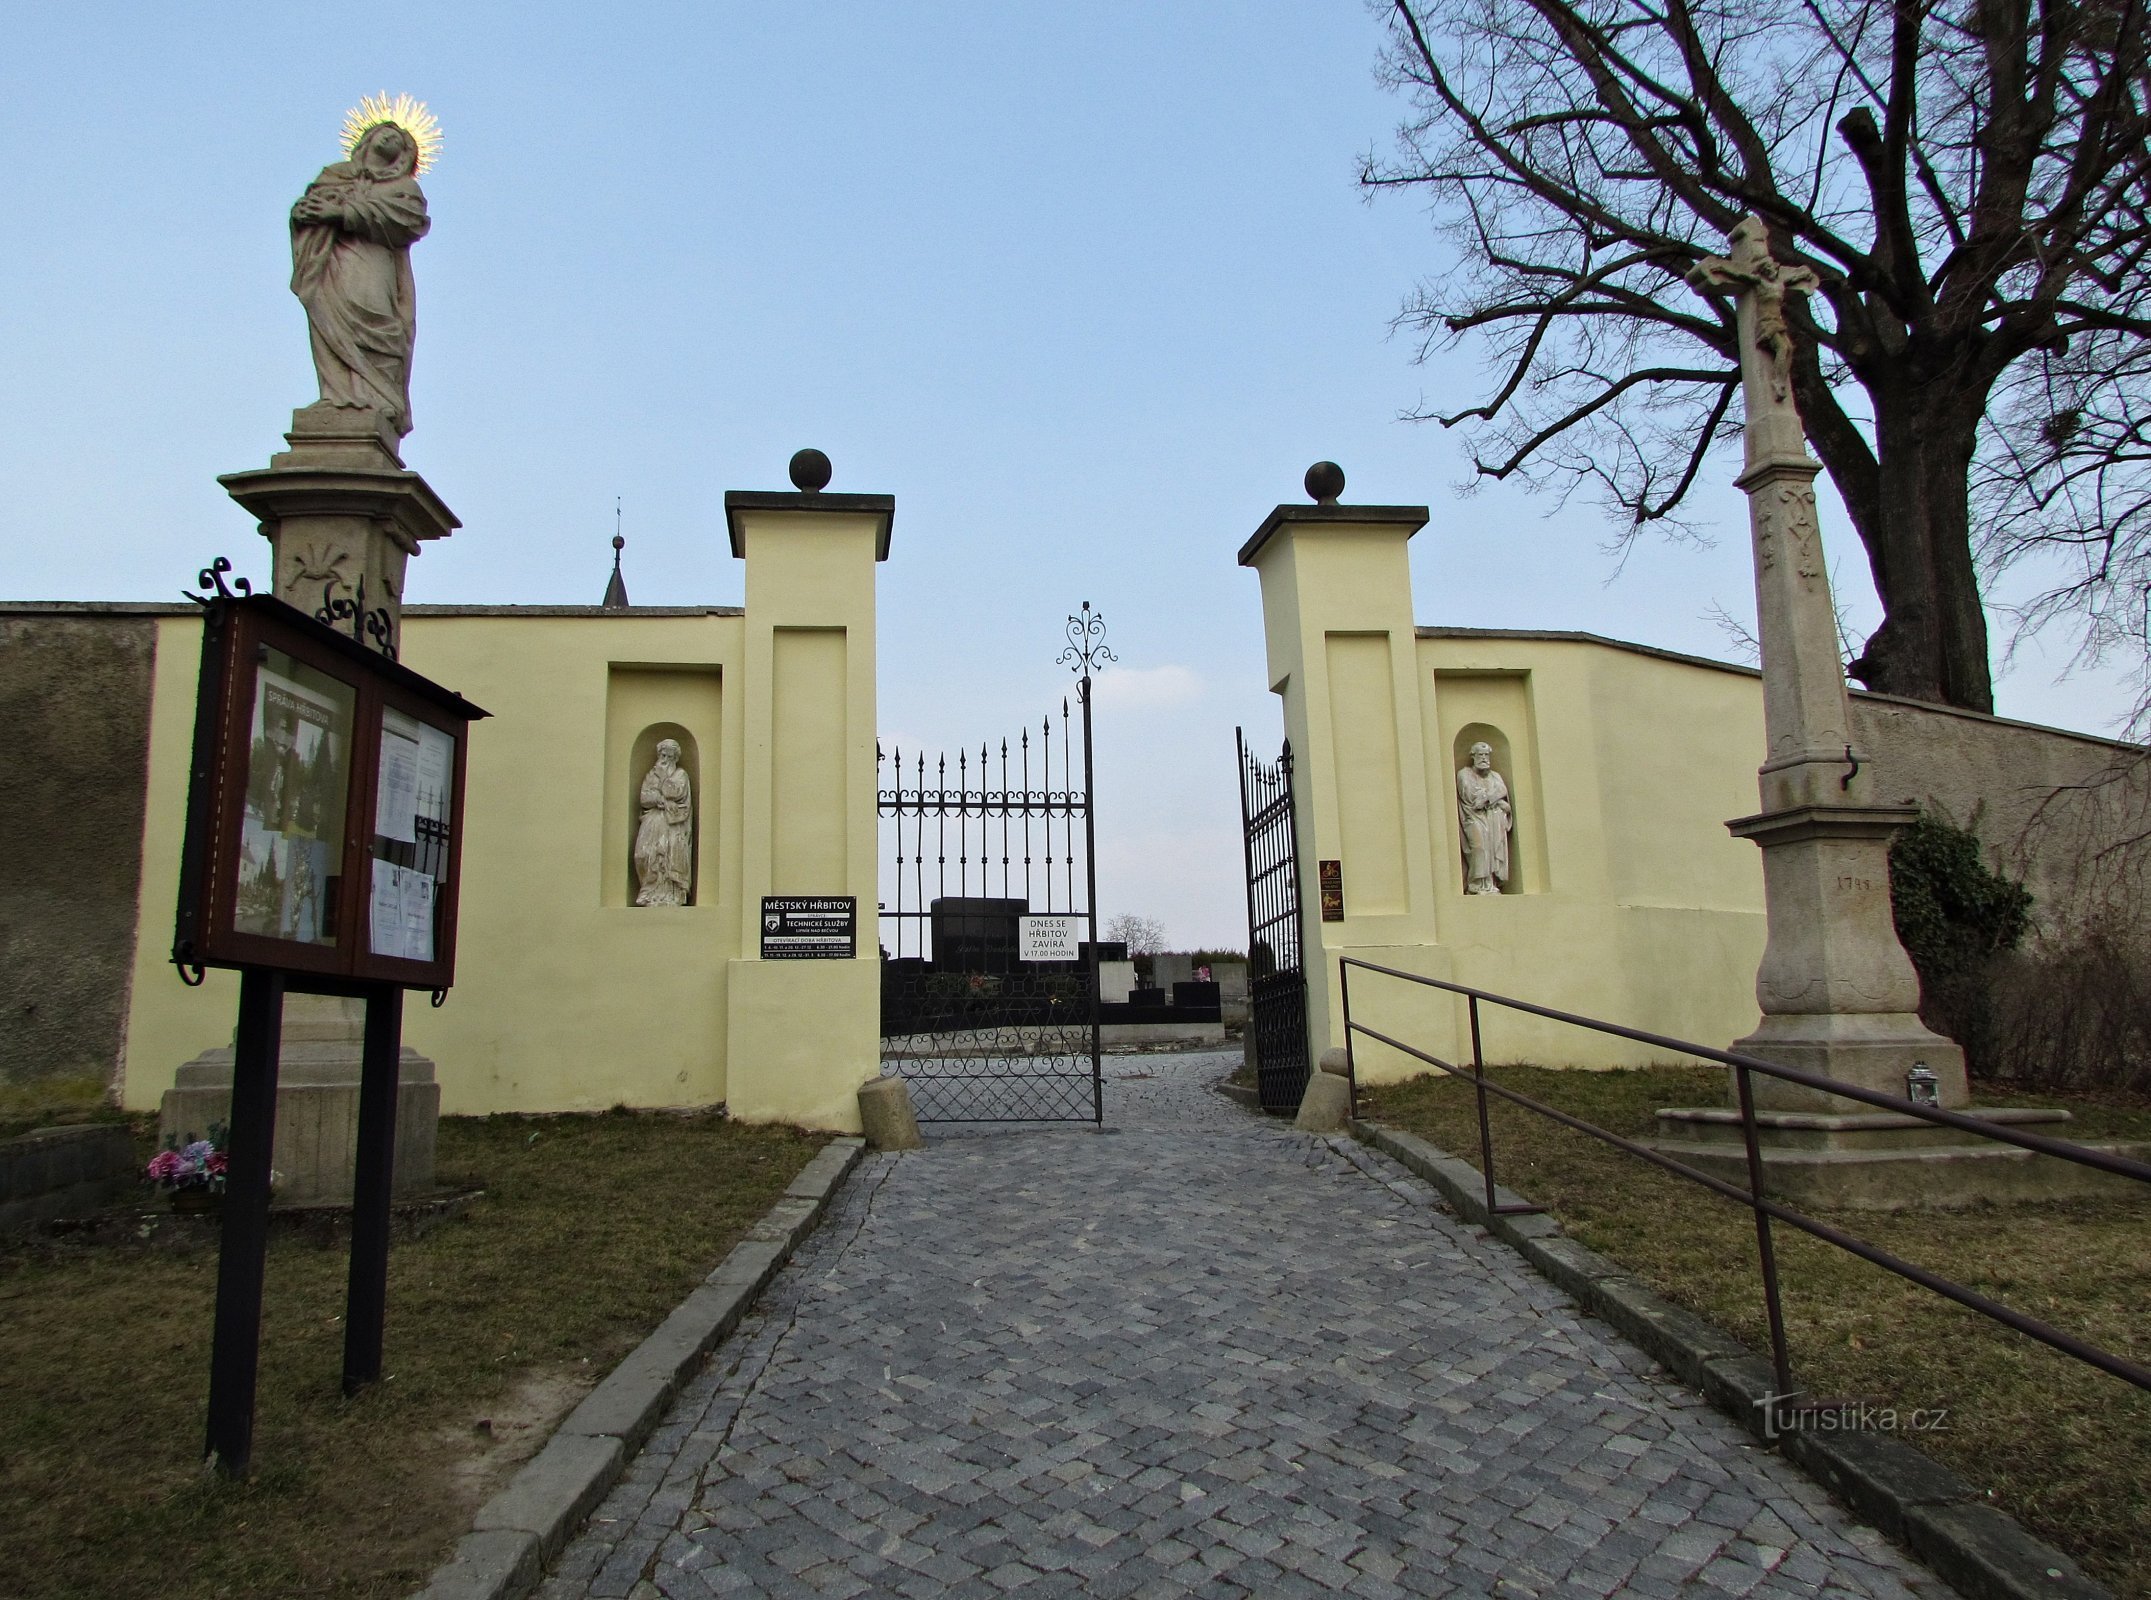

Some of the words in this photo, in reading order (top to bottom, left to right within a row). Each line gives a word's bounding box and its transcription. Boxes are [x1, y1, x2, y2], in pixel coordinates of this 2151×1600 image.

[268, 690, 295, 711] SPRÁVA
[765, 900, 808, 910] MĚSTSKÝ
[809, 900, 851, 910] HŘBITOV
[824, 919, 849, 927] SLUŽBY
[1030, 920, 1054, 928] DNES
[1056, 920, 1066, 928] SE
[1028, 929, 1068, 938] HŘBITOV
[1032, 938, 1065, 948] ZAVÍRÁ
